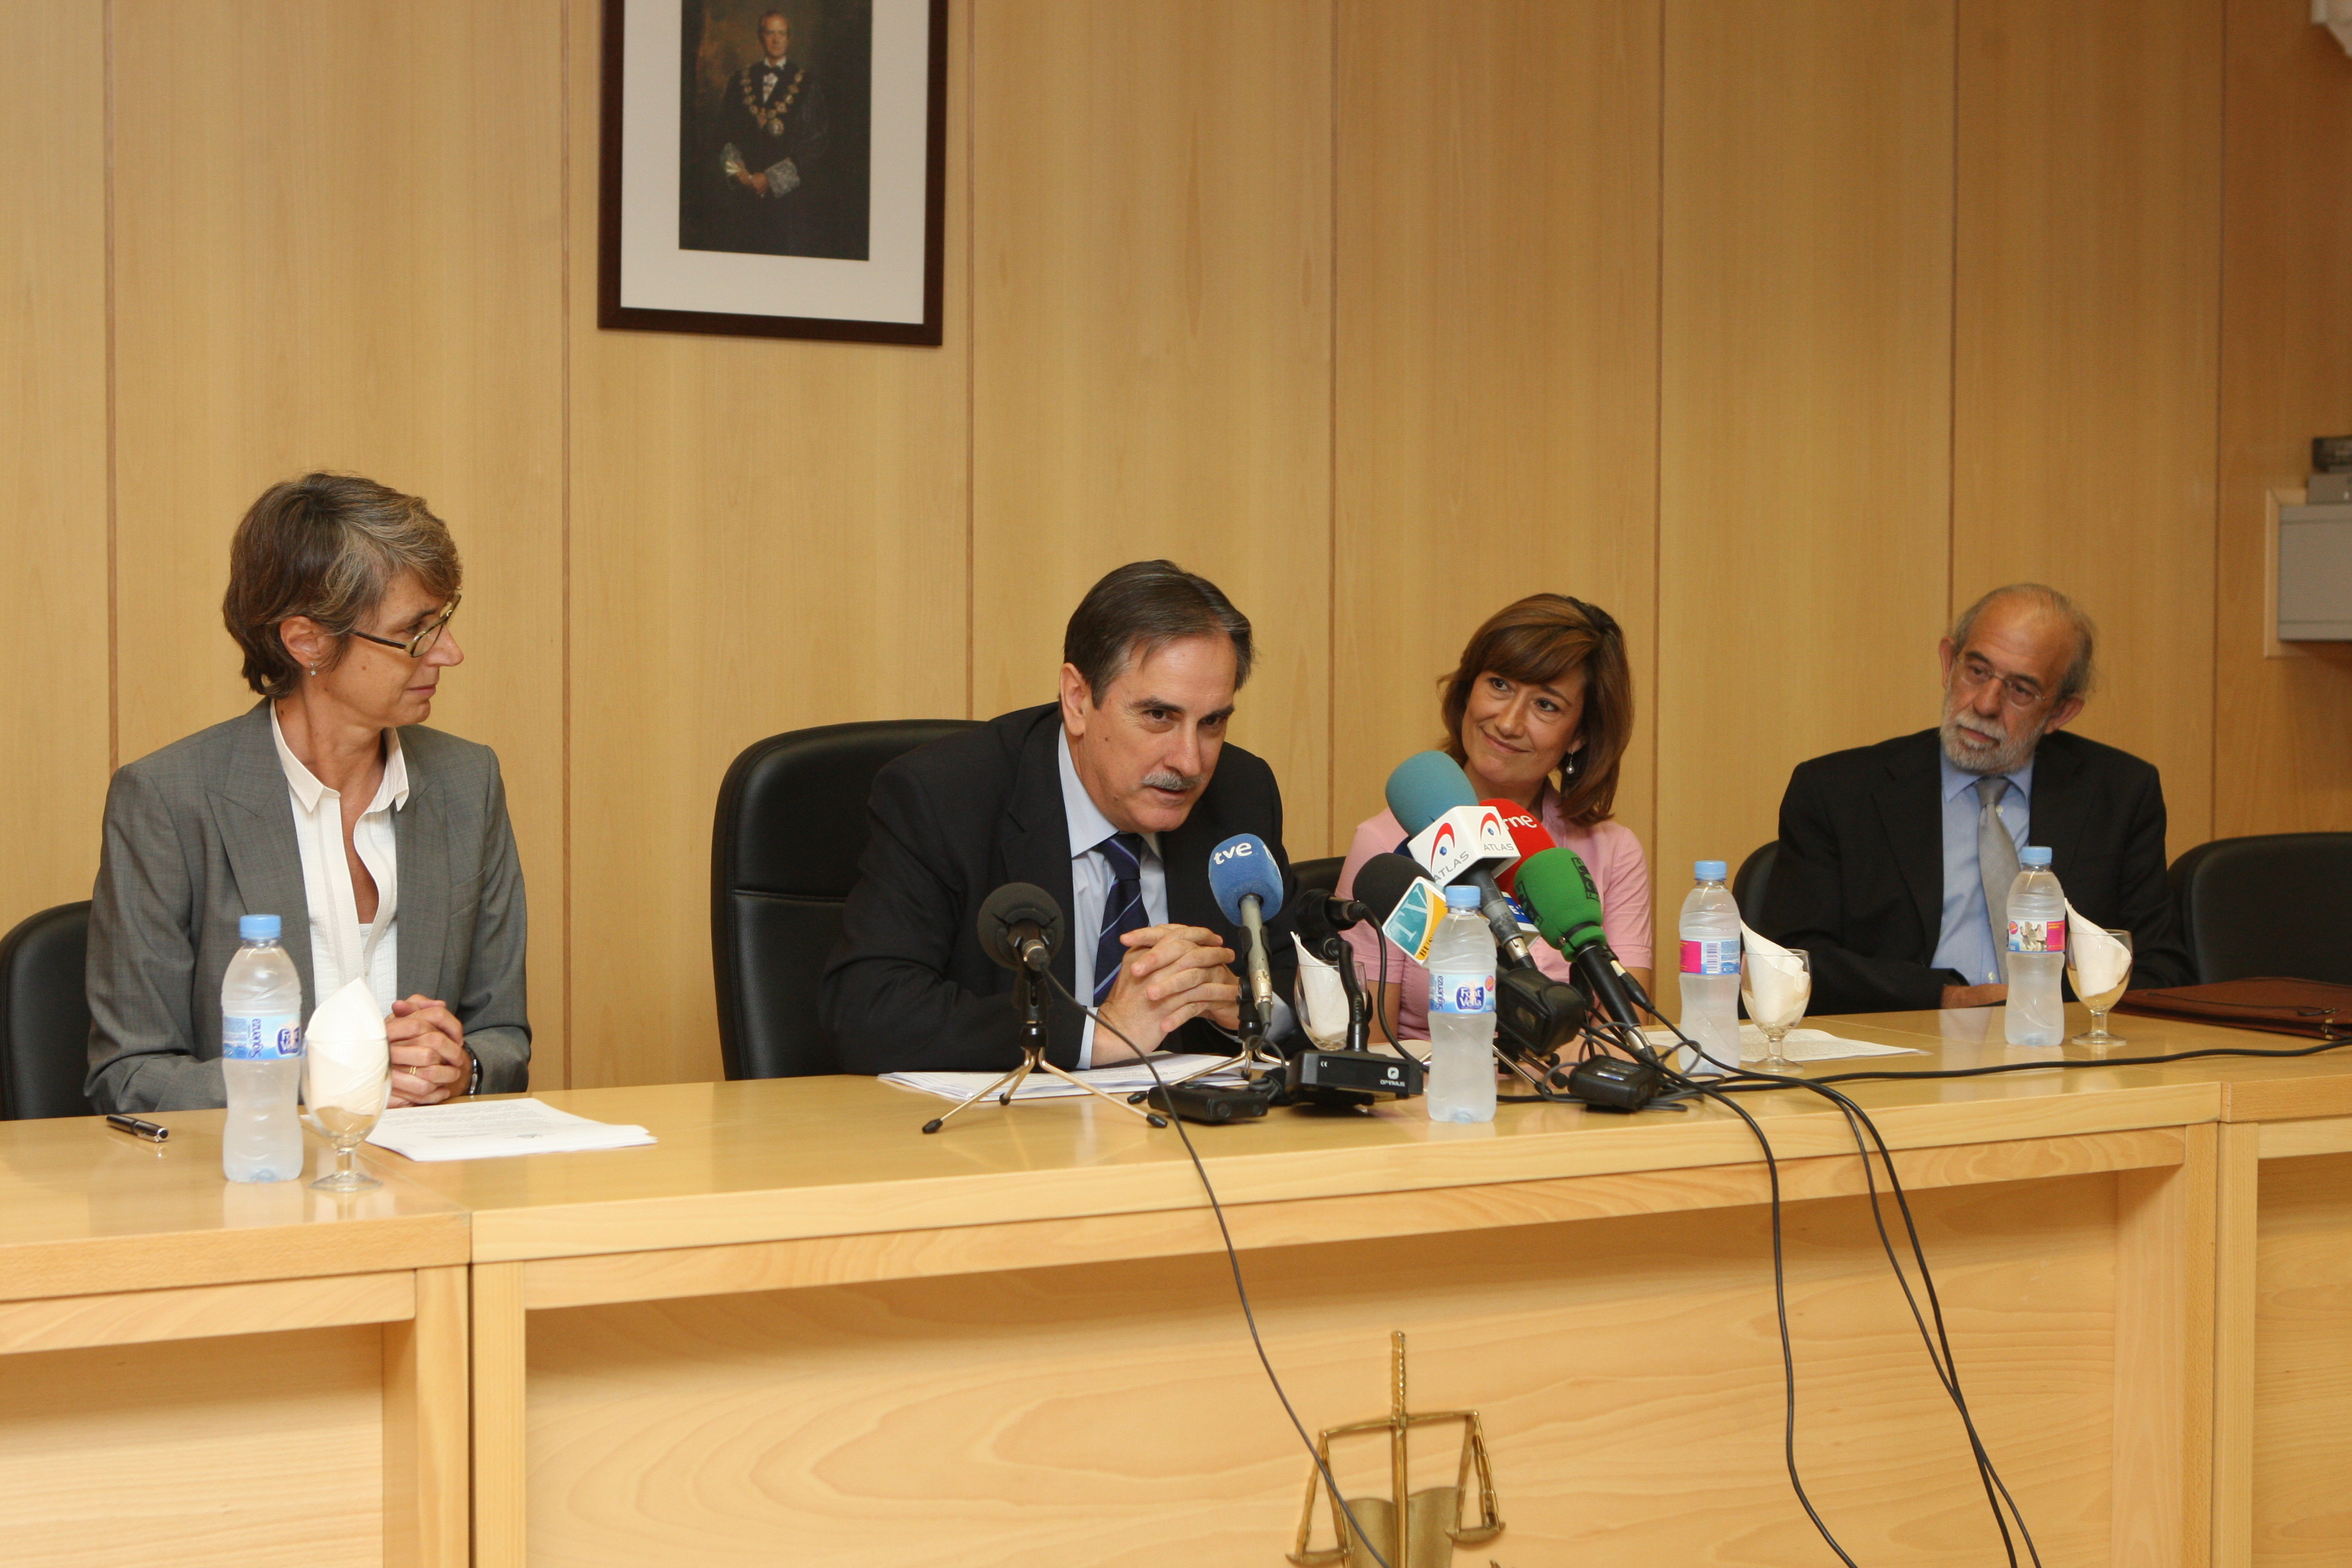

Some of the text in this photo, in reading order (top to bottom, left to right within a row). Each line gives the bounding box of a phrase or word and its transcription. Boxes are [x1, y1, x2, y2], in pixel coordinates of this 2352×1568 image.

[1502, 815, 1538, 831] rne
[1213, 842, 1253, 865] tve
[1483, 843, 1515, 852] ATLAS
[1433, 851, 1470, 882] ATLAS
[1388, 884, 1428, 942] TV
